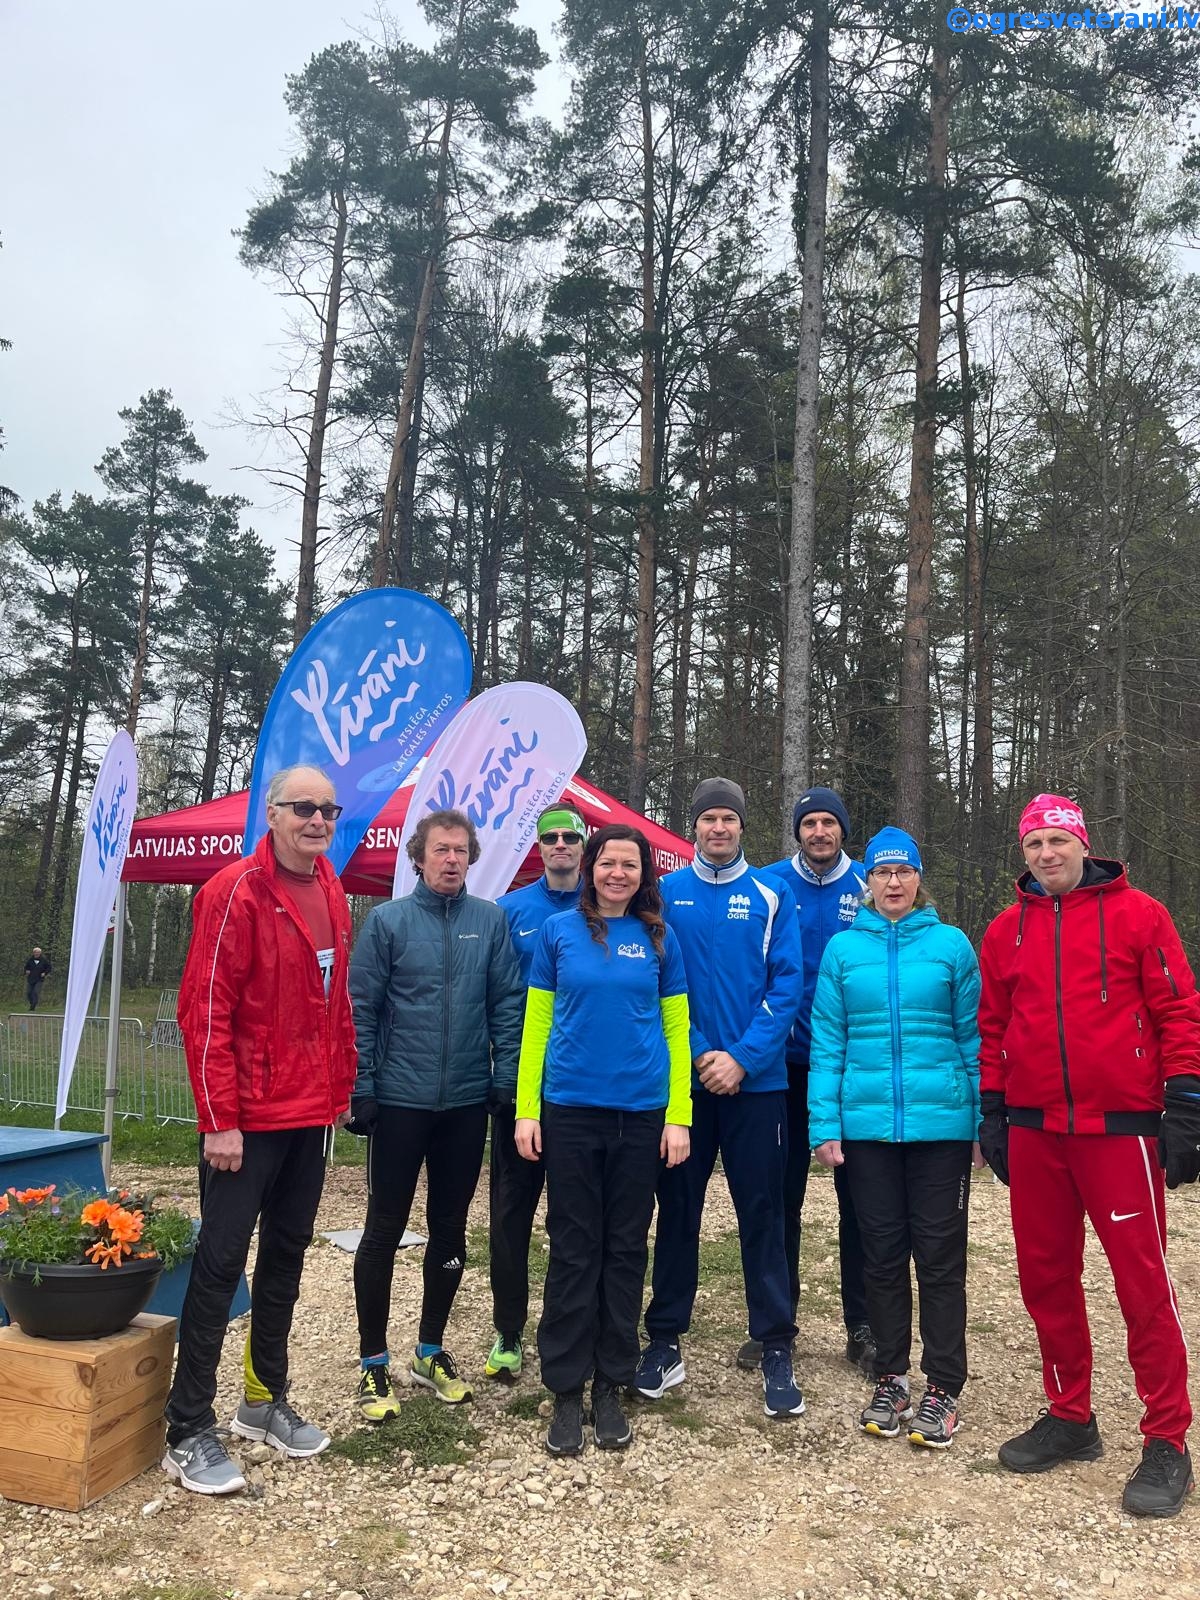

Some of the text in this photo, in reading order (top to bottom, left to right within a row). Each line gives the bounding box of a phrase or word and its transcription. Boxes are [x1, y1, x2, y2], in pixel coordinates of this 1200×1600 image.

[392, 693, 453, 773] LATGALES VĀRTOS
[398, 706, 428, 745] ATSLĒGA
[541, 770, 566, 806] VĀRTOS
[517, 788, 544, 829] ATSLĒGA
[126, 836, 196, 858] LATVIJAS
[200, 834, 244, 856] SPOR
[874, 849, 908, 859] ANTHOLZ
